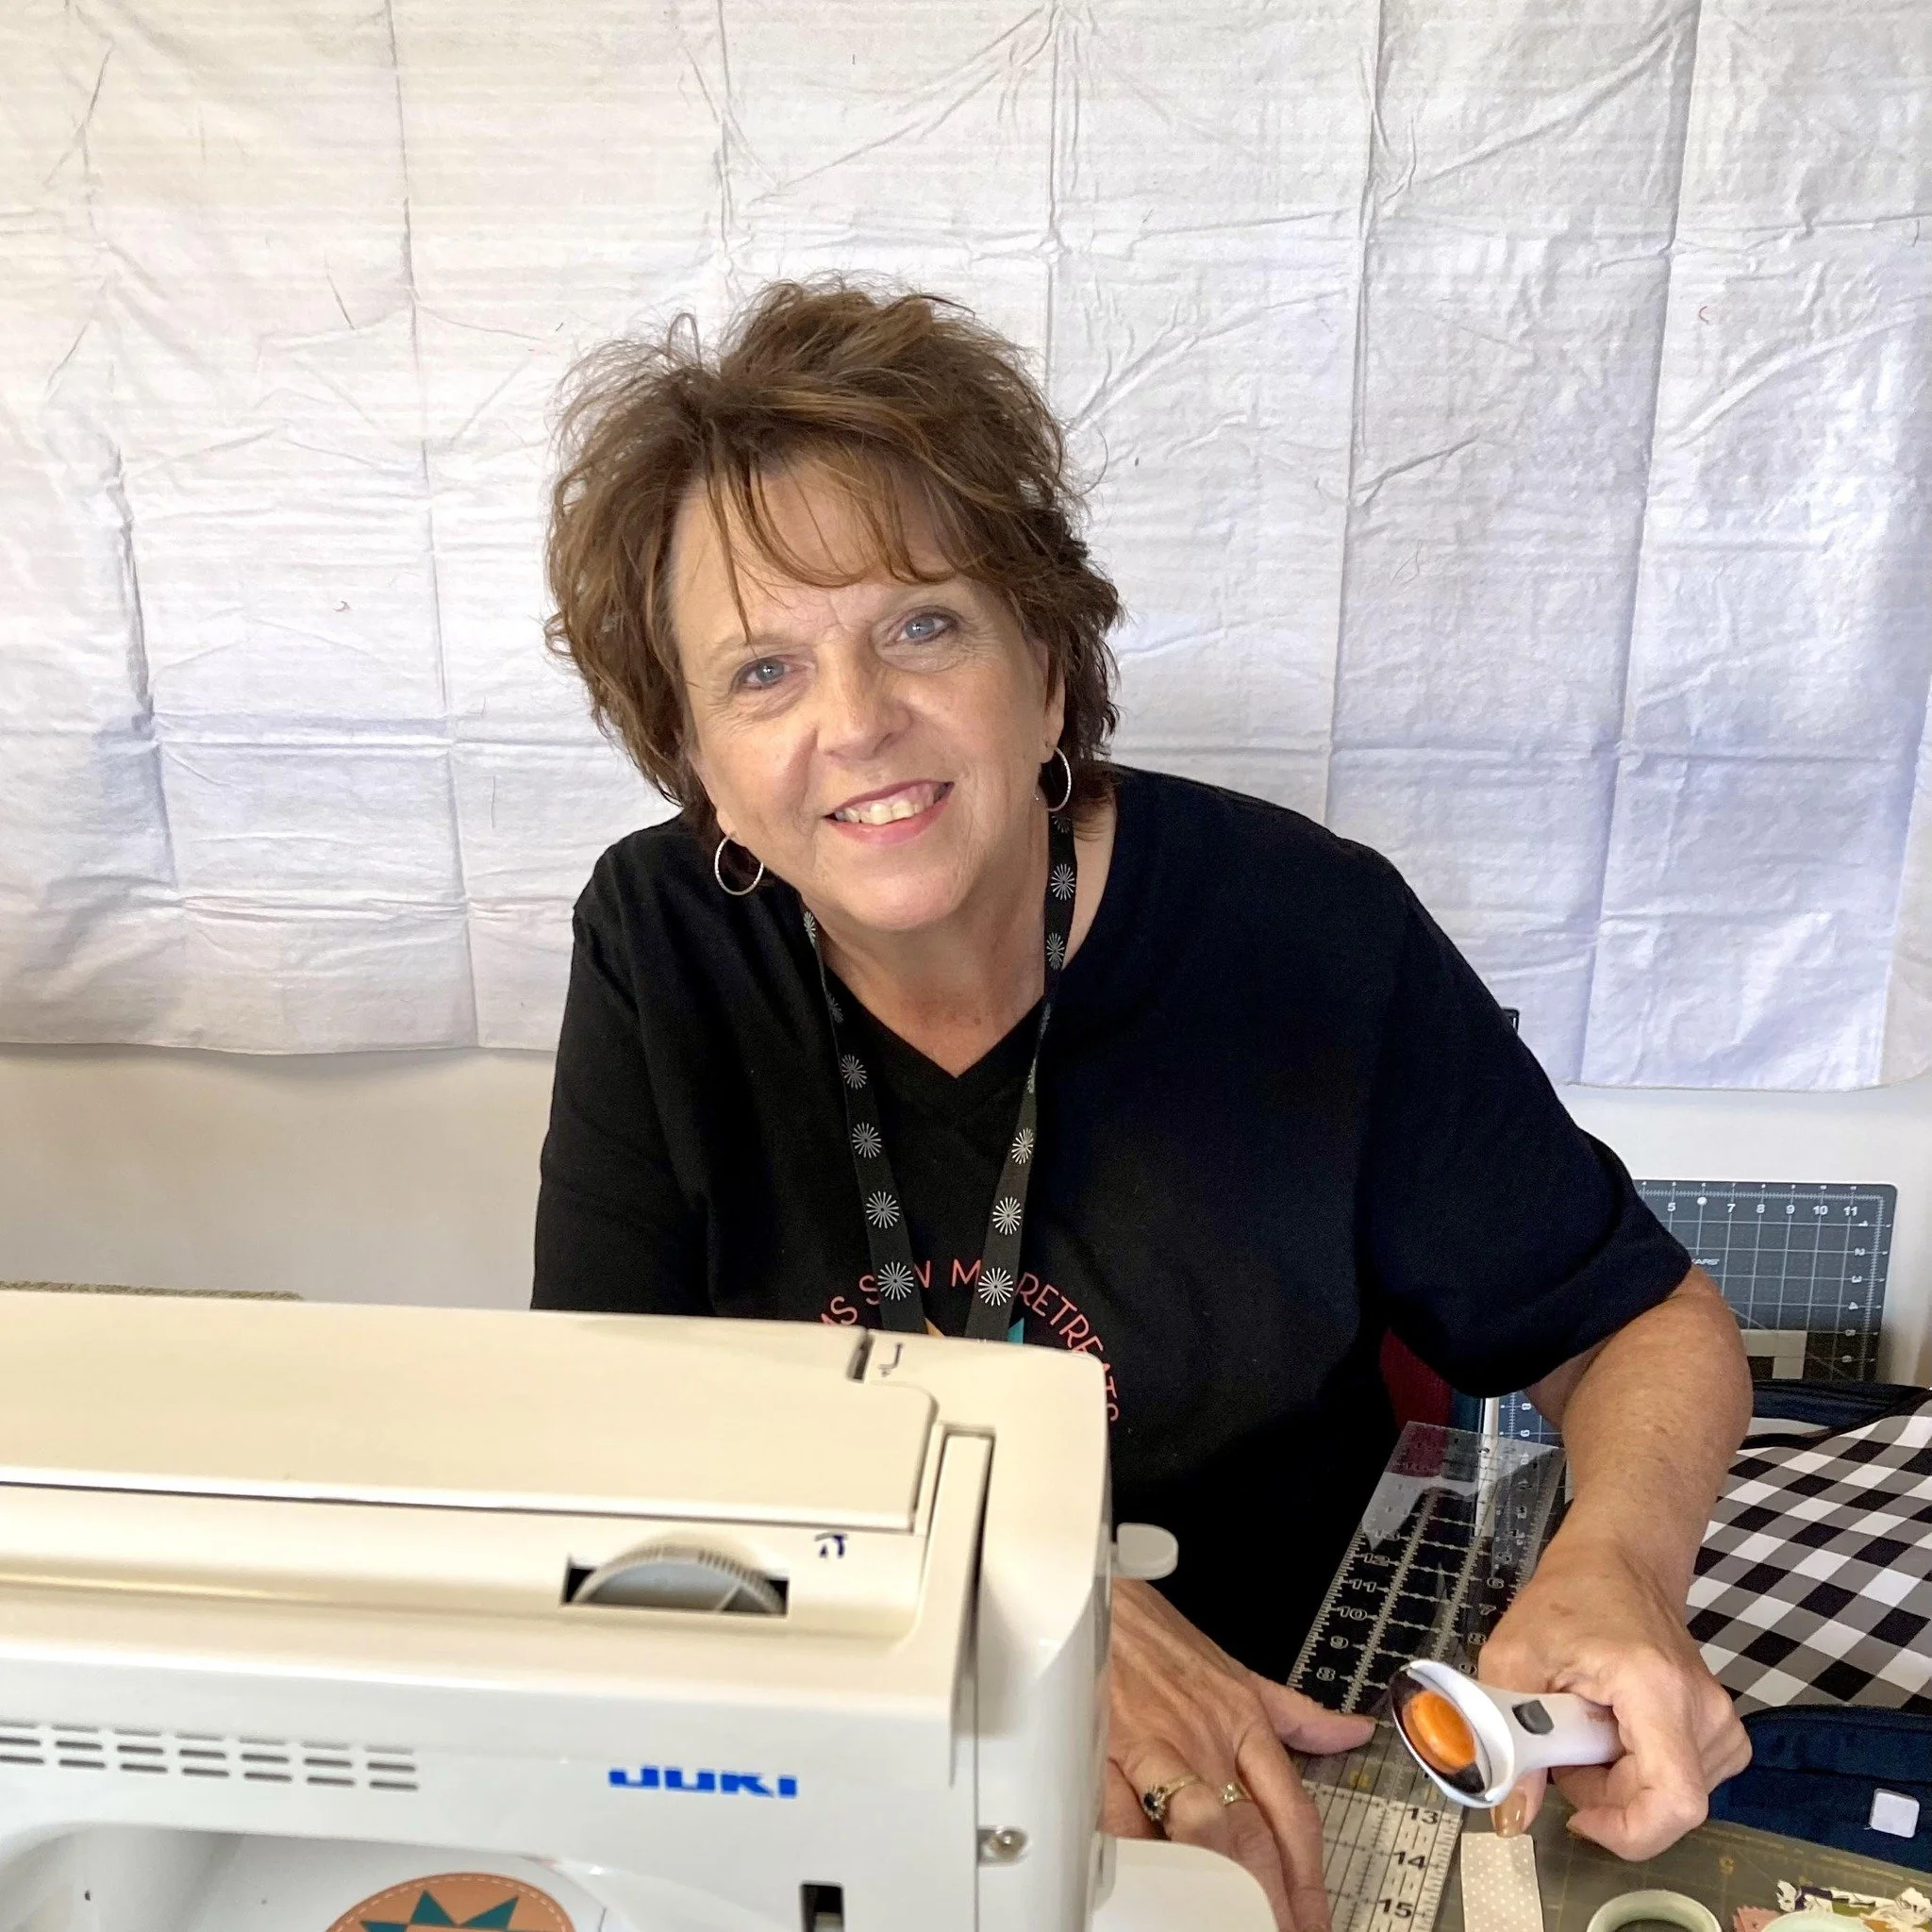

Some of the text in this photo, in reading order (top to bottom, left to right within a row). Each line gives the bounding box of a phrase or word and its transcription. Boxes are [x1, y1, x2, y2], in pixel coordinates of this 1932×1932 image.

[1667, 1202, 1858, 1217] 5 7 8 9 10 11
[608, 1765, 797, 1799] JUKI
[1407, 1807, 1440, 1825] 13
[1392, 1851, 1427, 1870] 14
[1377, 1898, 1413, 1919] 15
